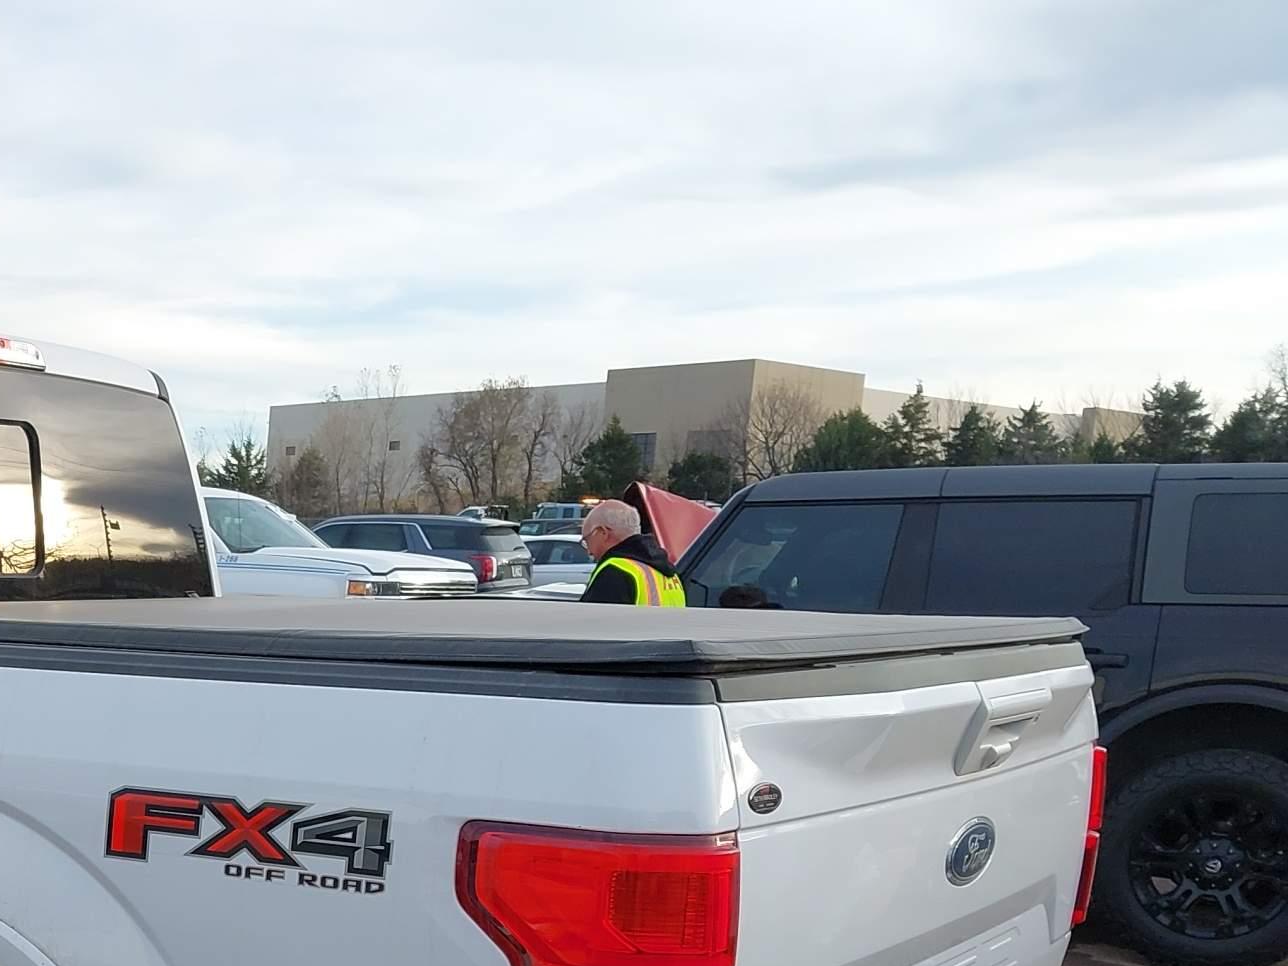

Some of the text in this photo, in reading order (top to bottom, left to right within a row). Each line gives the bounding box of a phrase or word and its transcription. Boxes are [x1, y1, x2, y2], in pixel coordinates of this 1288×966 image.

[104, 785, 395, 880] FX4
[960, 832, 991, 873] Ford
[224, 865, 385, 894] OFF ROAD
